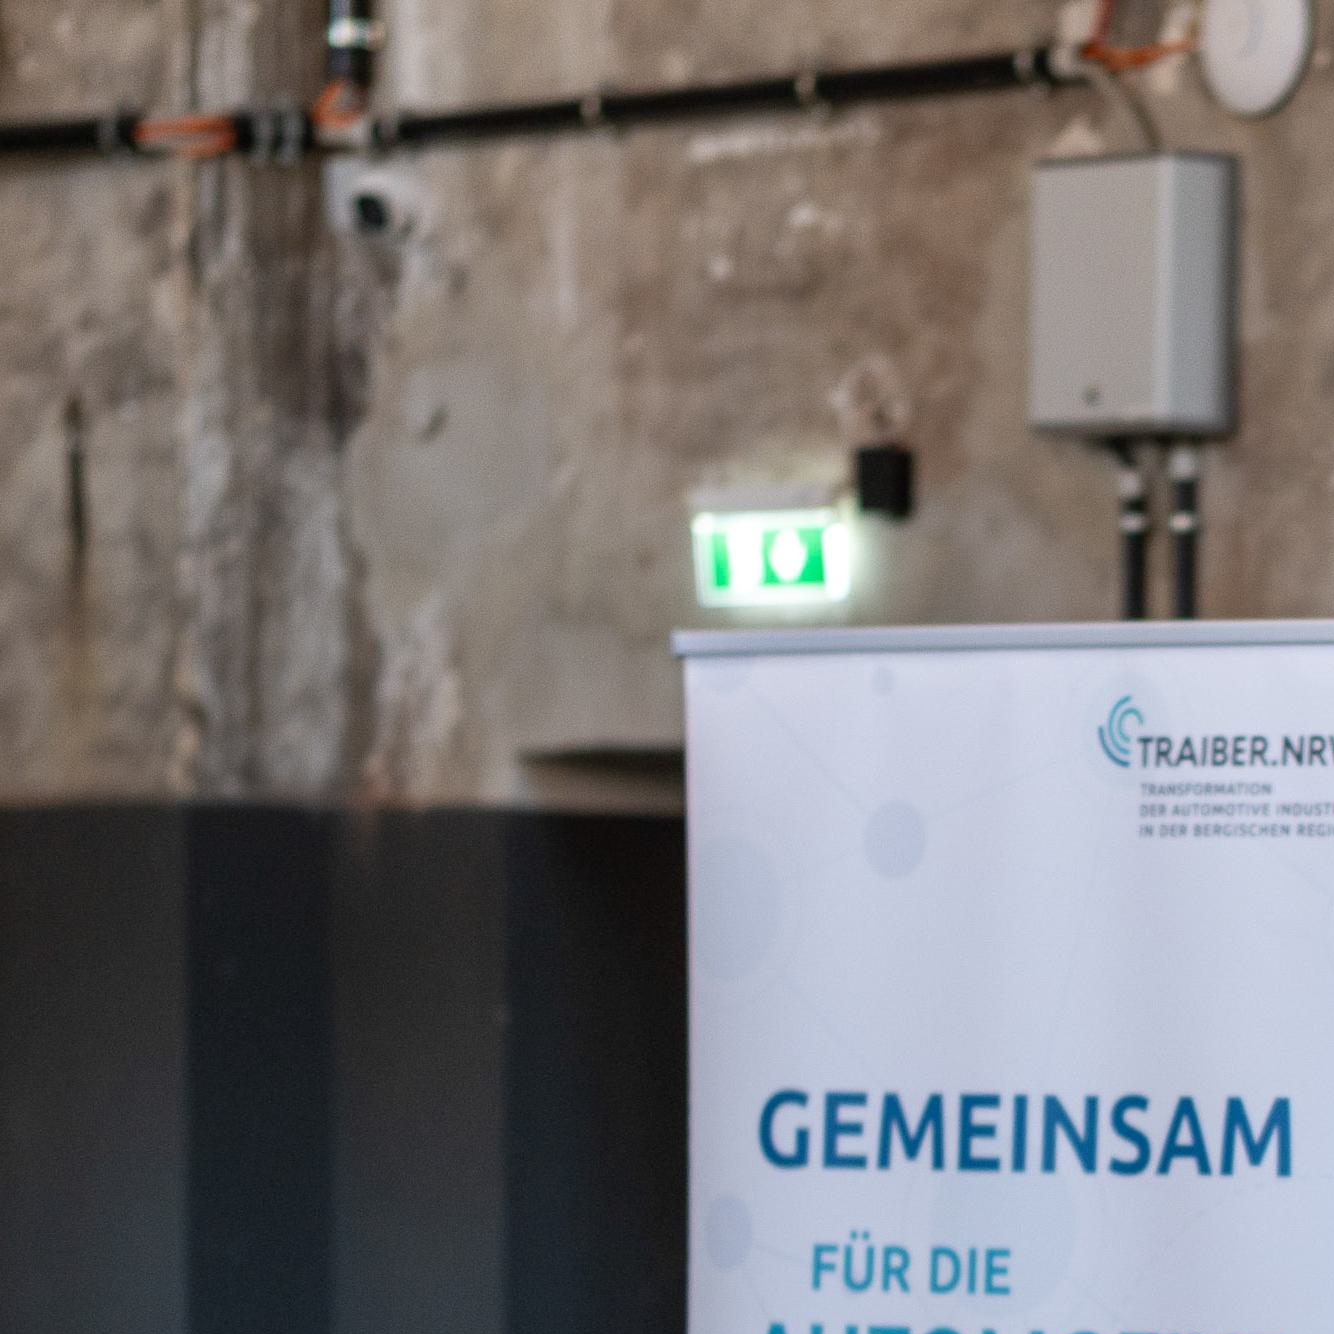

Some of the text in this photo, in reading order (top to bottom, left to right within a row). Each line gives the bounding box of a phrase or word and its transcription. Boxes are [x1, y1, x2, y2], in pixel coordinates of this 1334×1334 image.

[1140, 783, 1273, 797] TRANSFORMATION
[1139, 803, 1167, 818] DER
[1171, 803, 1271, 818] AUTOMOTIVE
[1138, 824, 1154, 839] IN
[1159, 824, 1188, 839] DER
[1193, 823, 1290, 838] BERGISCHEN
[758, 1089, 1292, 1178] GEMEINSAM
[812, 1230, 1012, 1295] FÜR DIE
